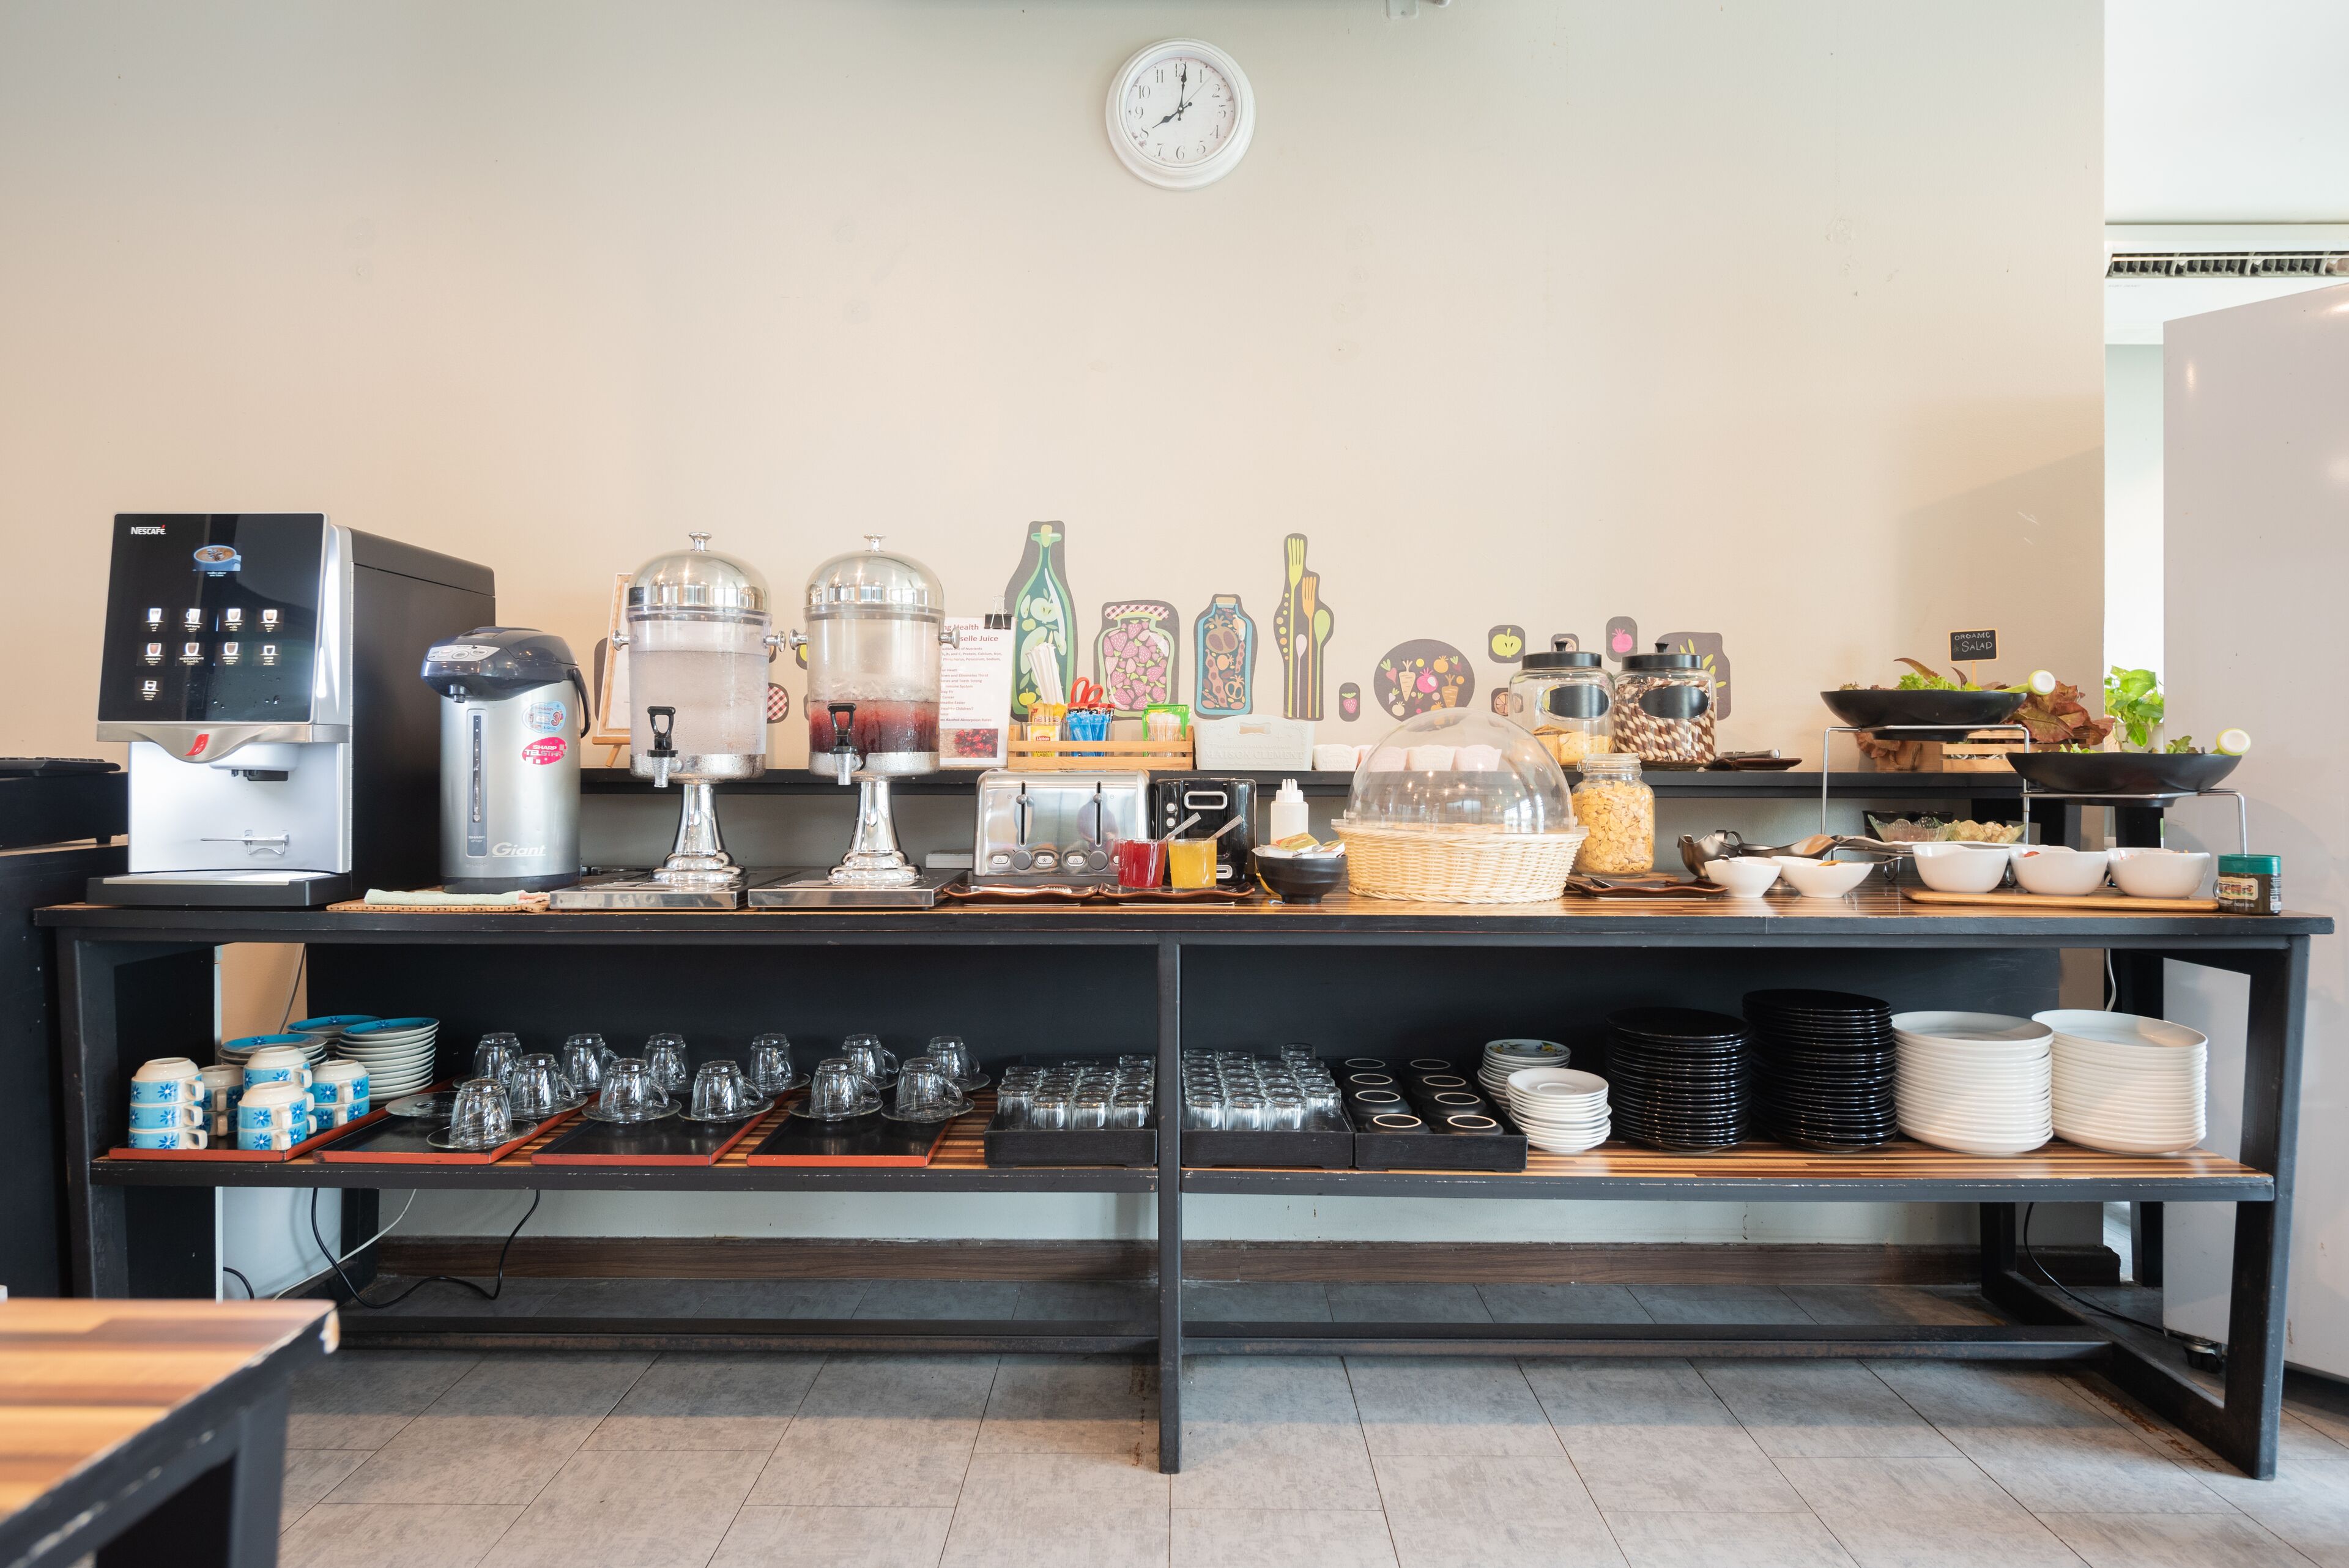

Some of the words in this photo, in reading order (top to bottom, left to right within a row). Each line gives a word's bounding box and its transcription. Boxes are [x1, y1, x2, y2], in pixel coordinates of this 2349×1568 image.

[1156, 69, 1163, 83] 11
[1199, 69, 1203, 83] 1
[1139, 85, 1151, 99] 10
[1135, 106, 1143, 119] 9
[1140, 126, 1149, 139] 8
[1209, 125, 1219, 139] 4
[1157, 143, 1165, 157] 7
[1176, 146, 1185, 160] 6
[1197, 140, 1206, 154] 5
[551, 712, 560, 726] 3
[492, 842, 546, 856] Giant
